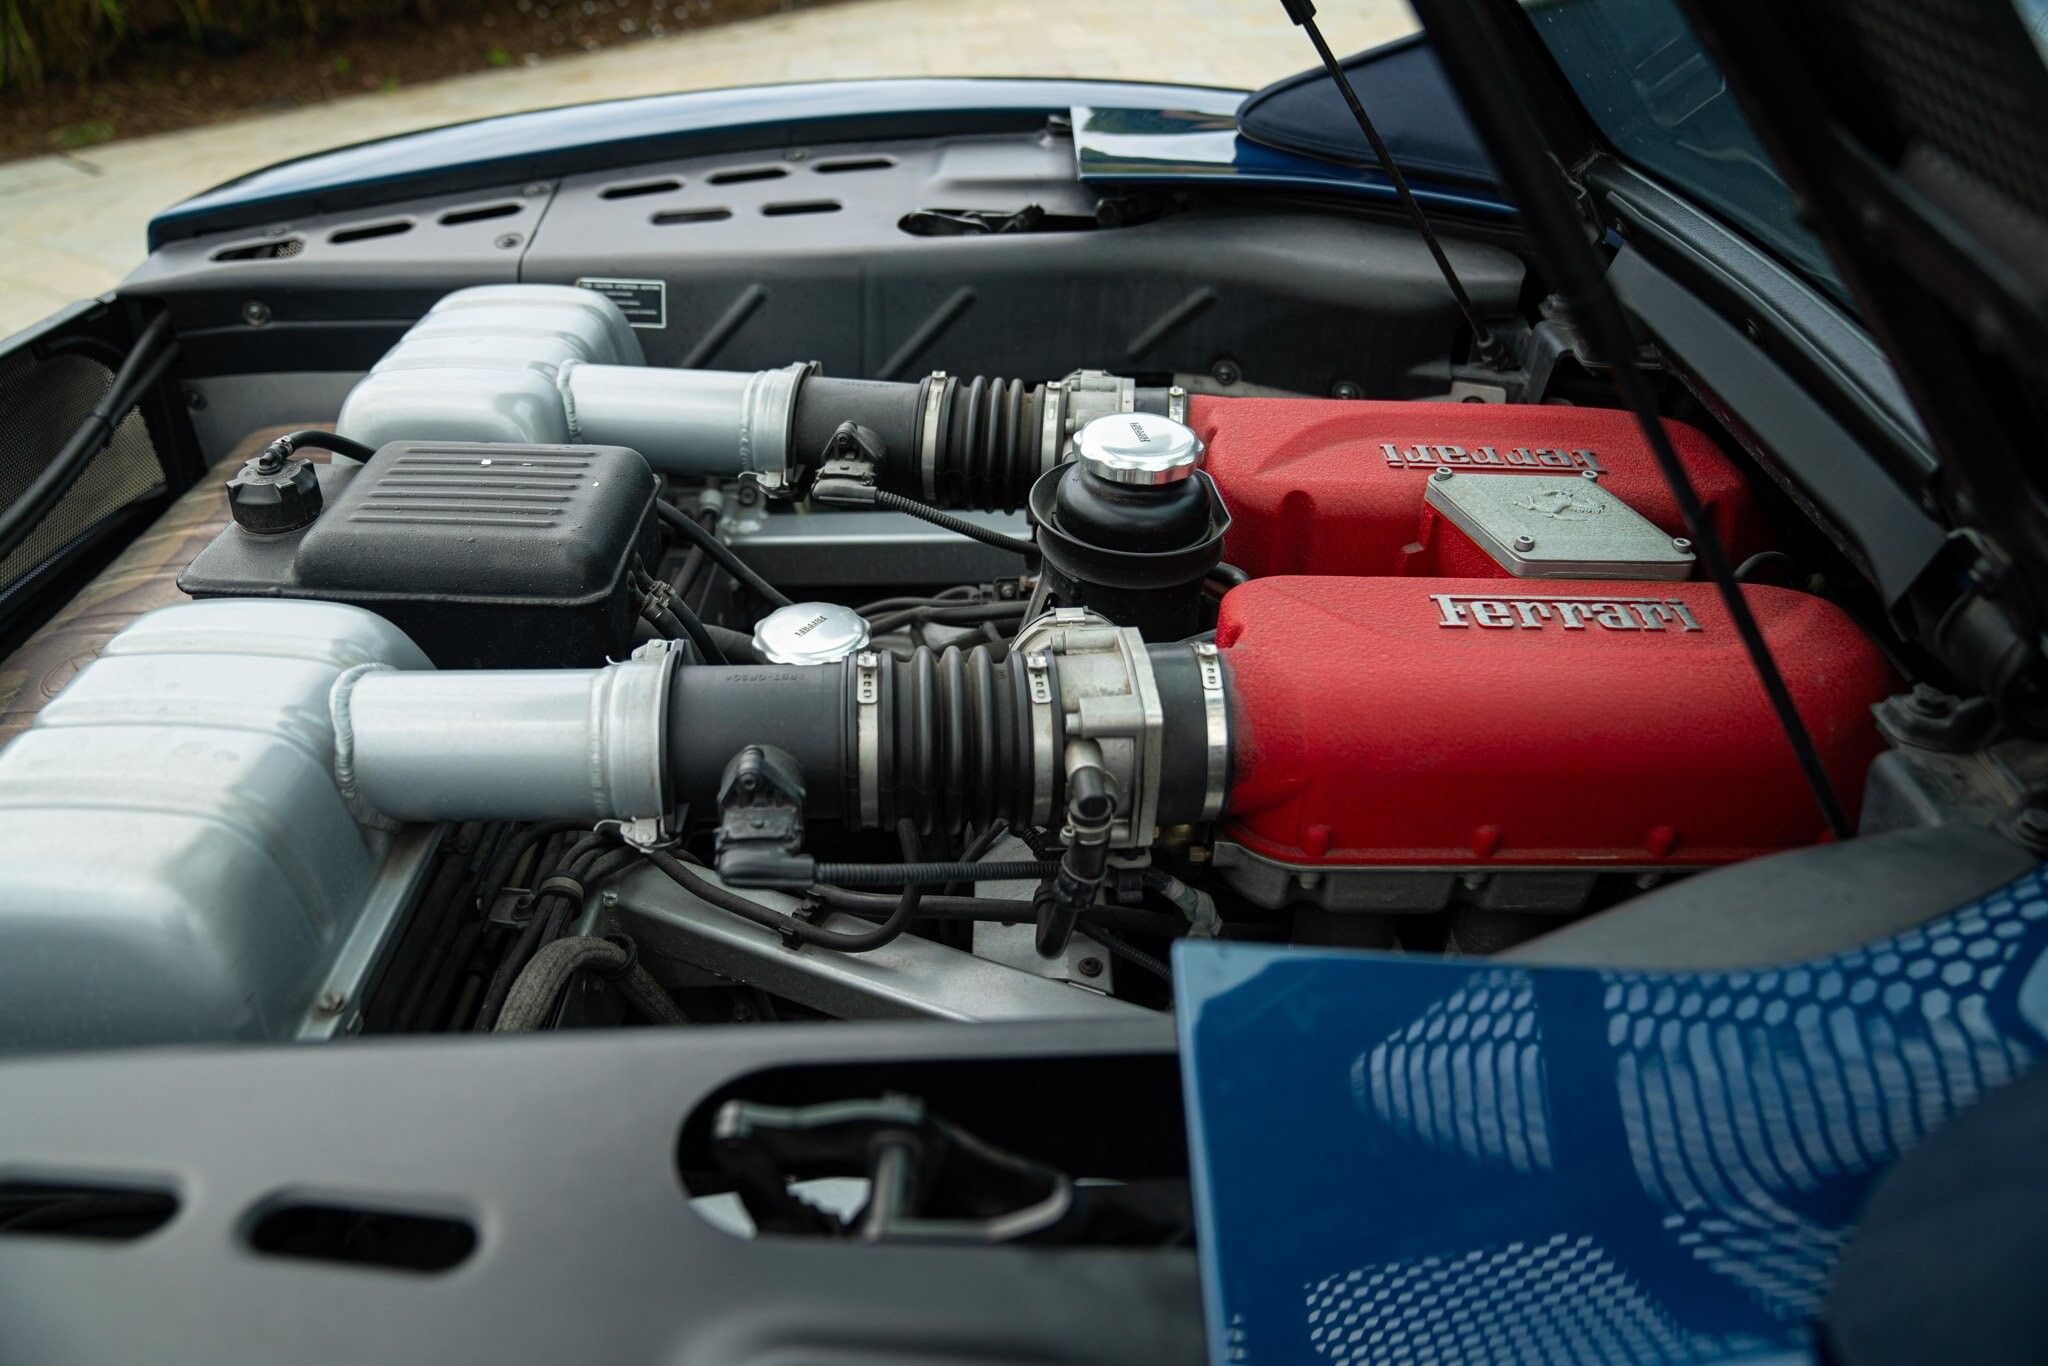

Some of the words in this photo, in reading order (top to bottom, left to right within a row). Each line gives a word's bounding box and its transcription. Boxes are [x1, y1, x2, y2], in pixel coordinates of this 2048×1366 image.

[1380, 443, 1607, 474] Ferrari
[794, 615, 828, 637] Ferrari
[1429, 594, 1703, 632] Ferrari
